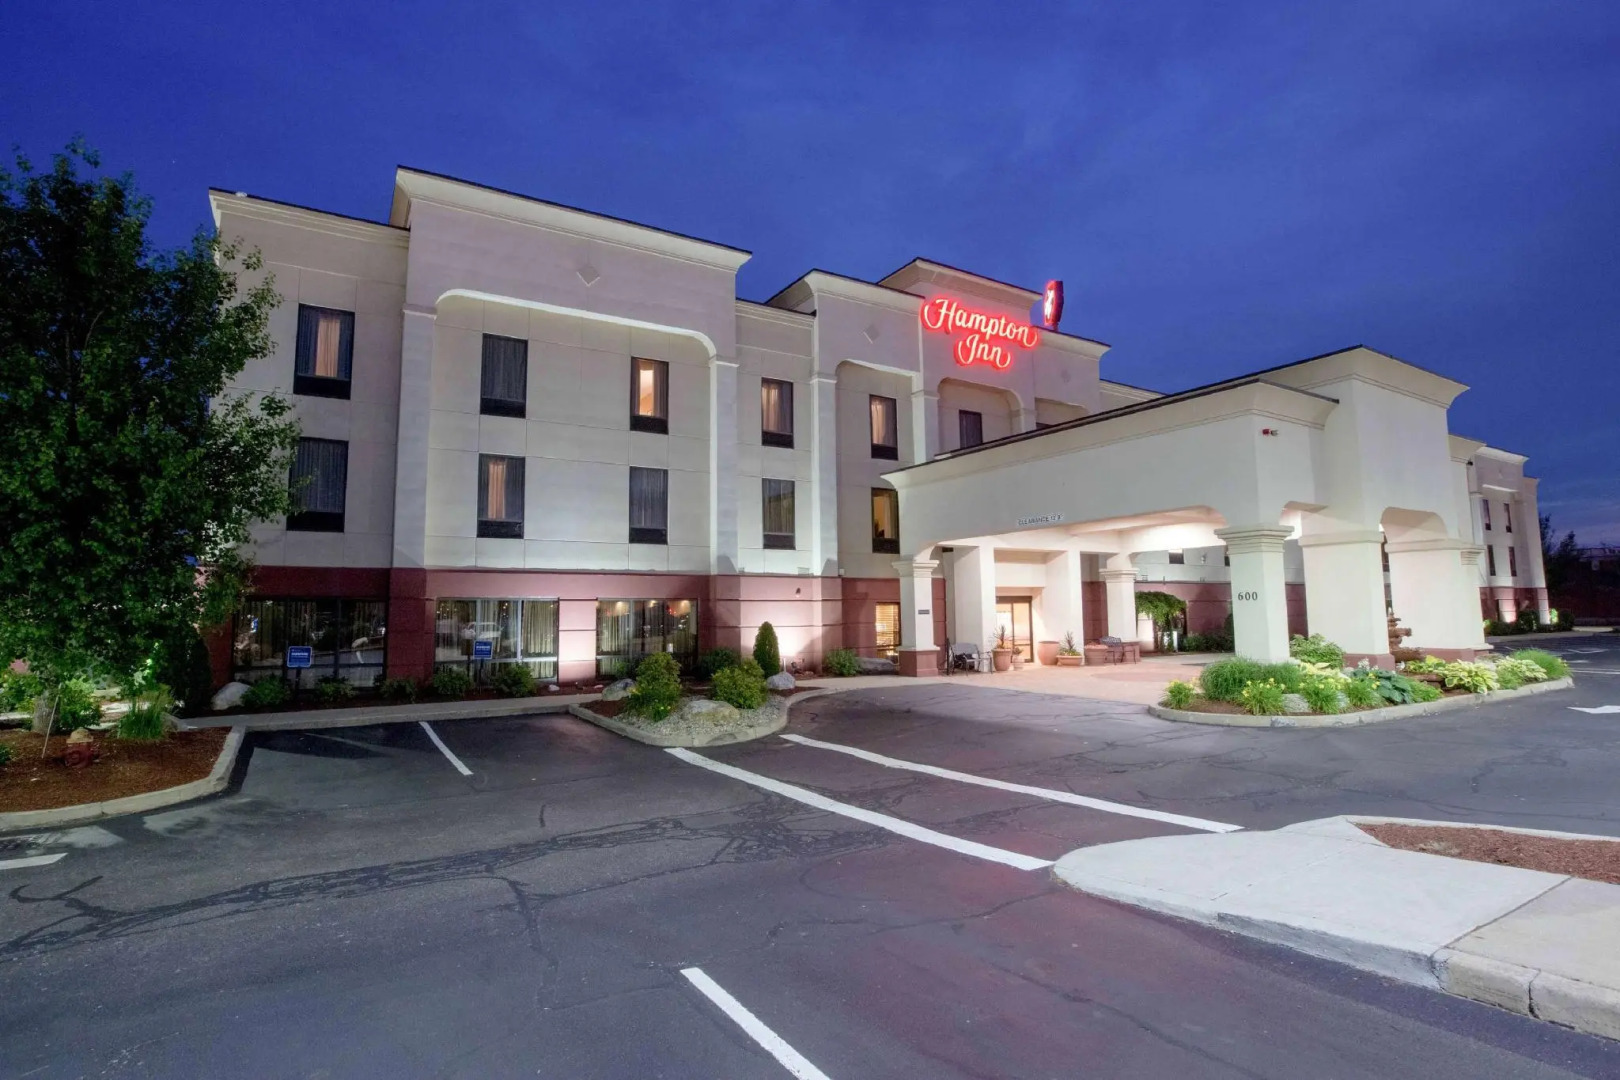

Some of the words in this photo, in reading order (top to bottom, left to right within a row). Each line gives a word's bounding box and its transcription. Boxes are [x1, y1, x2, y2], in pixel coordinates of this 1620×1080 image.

[923, 298, 1038, 347] Hampton
[957, 333, 1011, 368] Inn
[1237, 591, 1258, 601] 600
